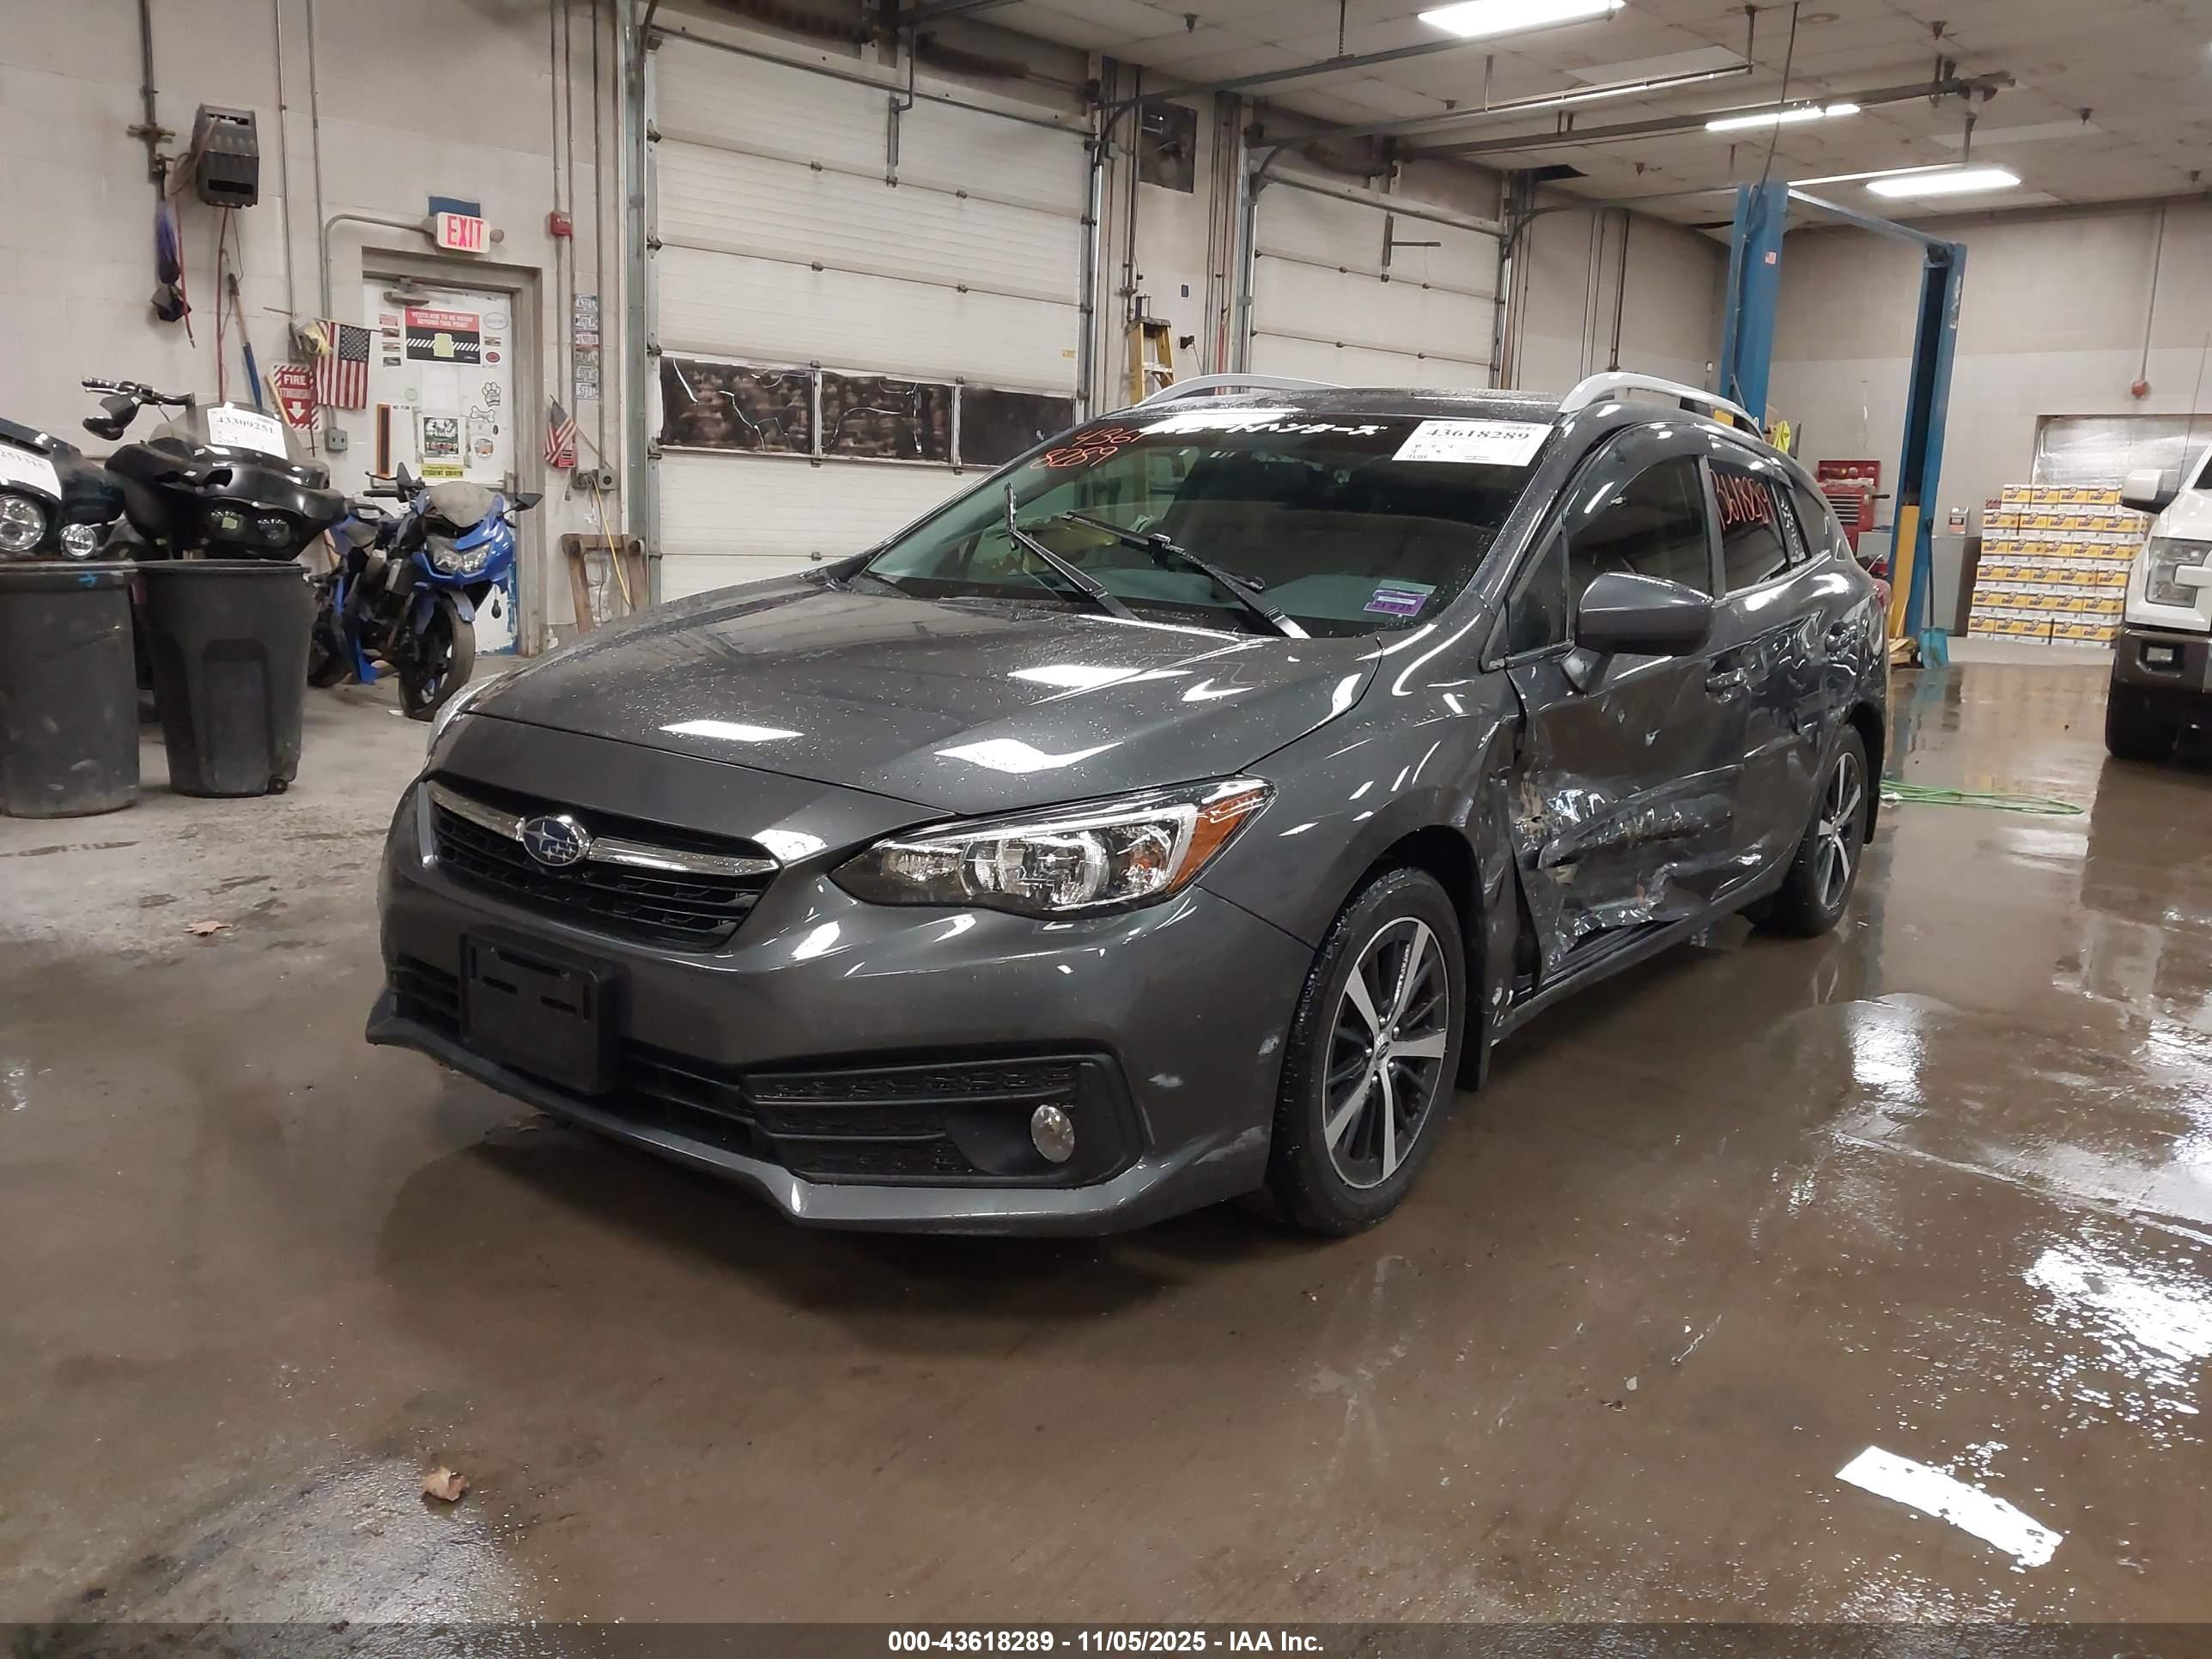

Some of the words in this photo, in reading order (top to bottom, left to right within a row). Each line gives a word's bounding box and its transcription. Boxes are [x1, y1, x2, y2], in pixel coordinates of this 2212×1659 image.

[447, 215, 483, 249] EXIT
[283, 374, 307, 386] FIRE
[216, 416, 273, 433] 43309251
[1425, 428, 1530, 441] 43618289
[1030, 447, 1119, 469] 8289
